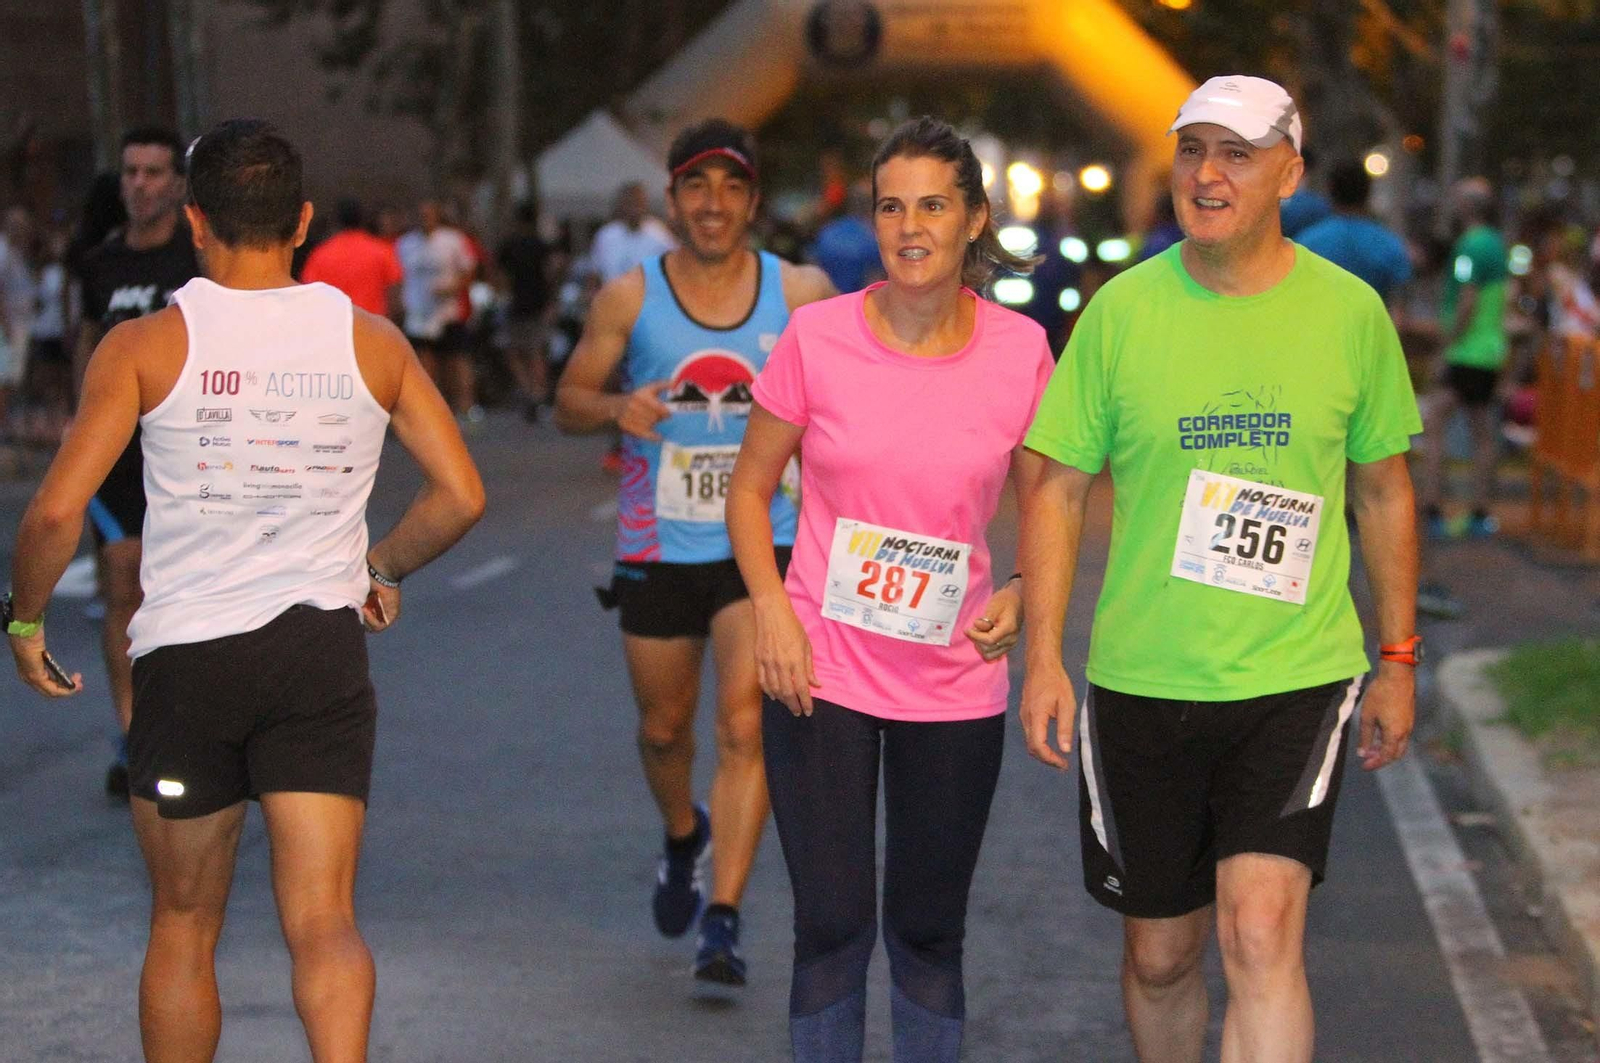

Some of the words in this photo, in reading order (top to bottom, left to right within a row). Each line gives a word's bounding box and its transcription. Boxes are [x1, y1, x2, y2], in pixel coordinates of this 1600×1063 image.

[265, 372, 354, 400] ACTITUD
[1178, 412, 1291, 433] CORREDOR
[1180, 431, 1290, 450] COMPLETO
[1229, 501, 1254, 516] DE
[1255, 507, 1310, 528] HUELVA
[1237, 488, 1316, 515] NOCTURNA
[847, 530, 884, 559] VII
[881, 536, 961, 561] NOCTURNA
[1209, 513, 1287, 564] 256
[875, 549, 898, 562] DE
[899, 552, 956, 575] HUELVA
[1238, 557, 1265, 571] CARLOS
[857, 560, 931, 609] 287
